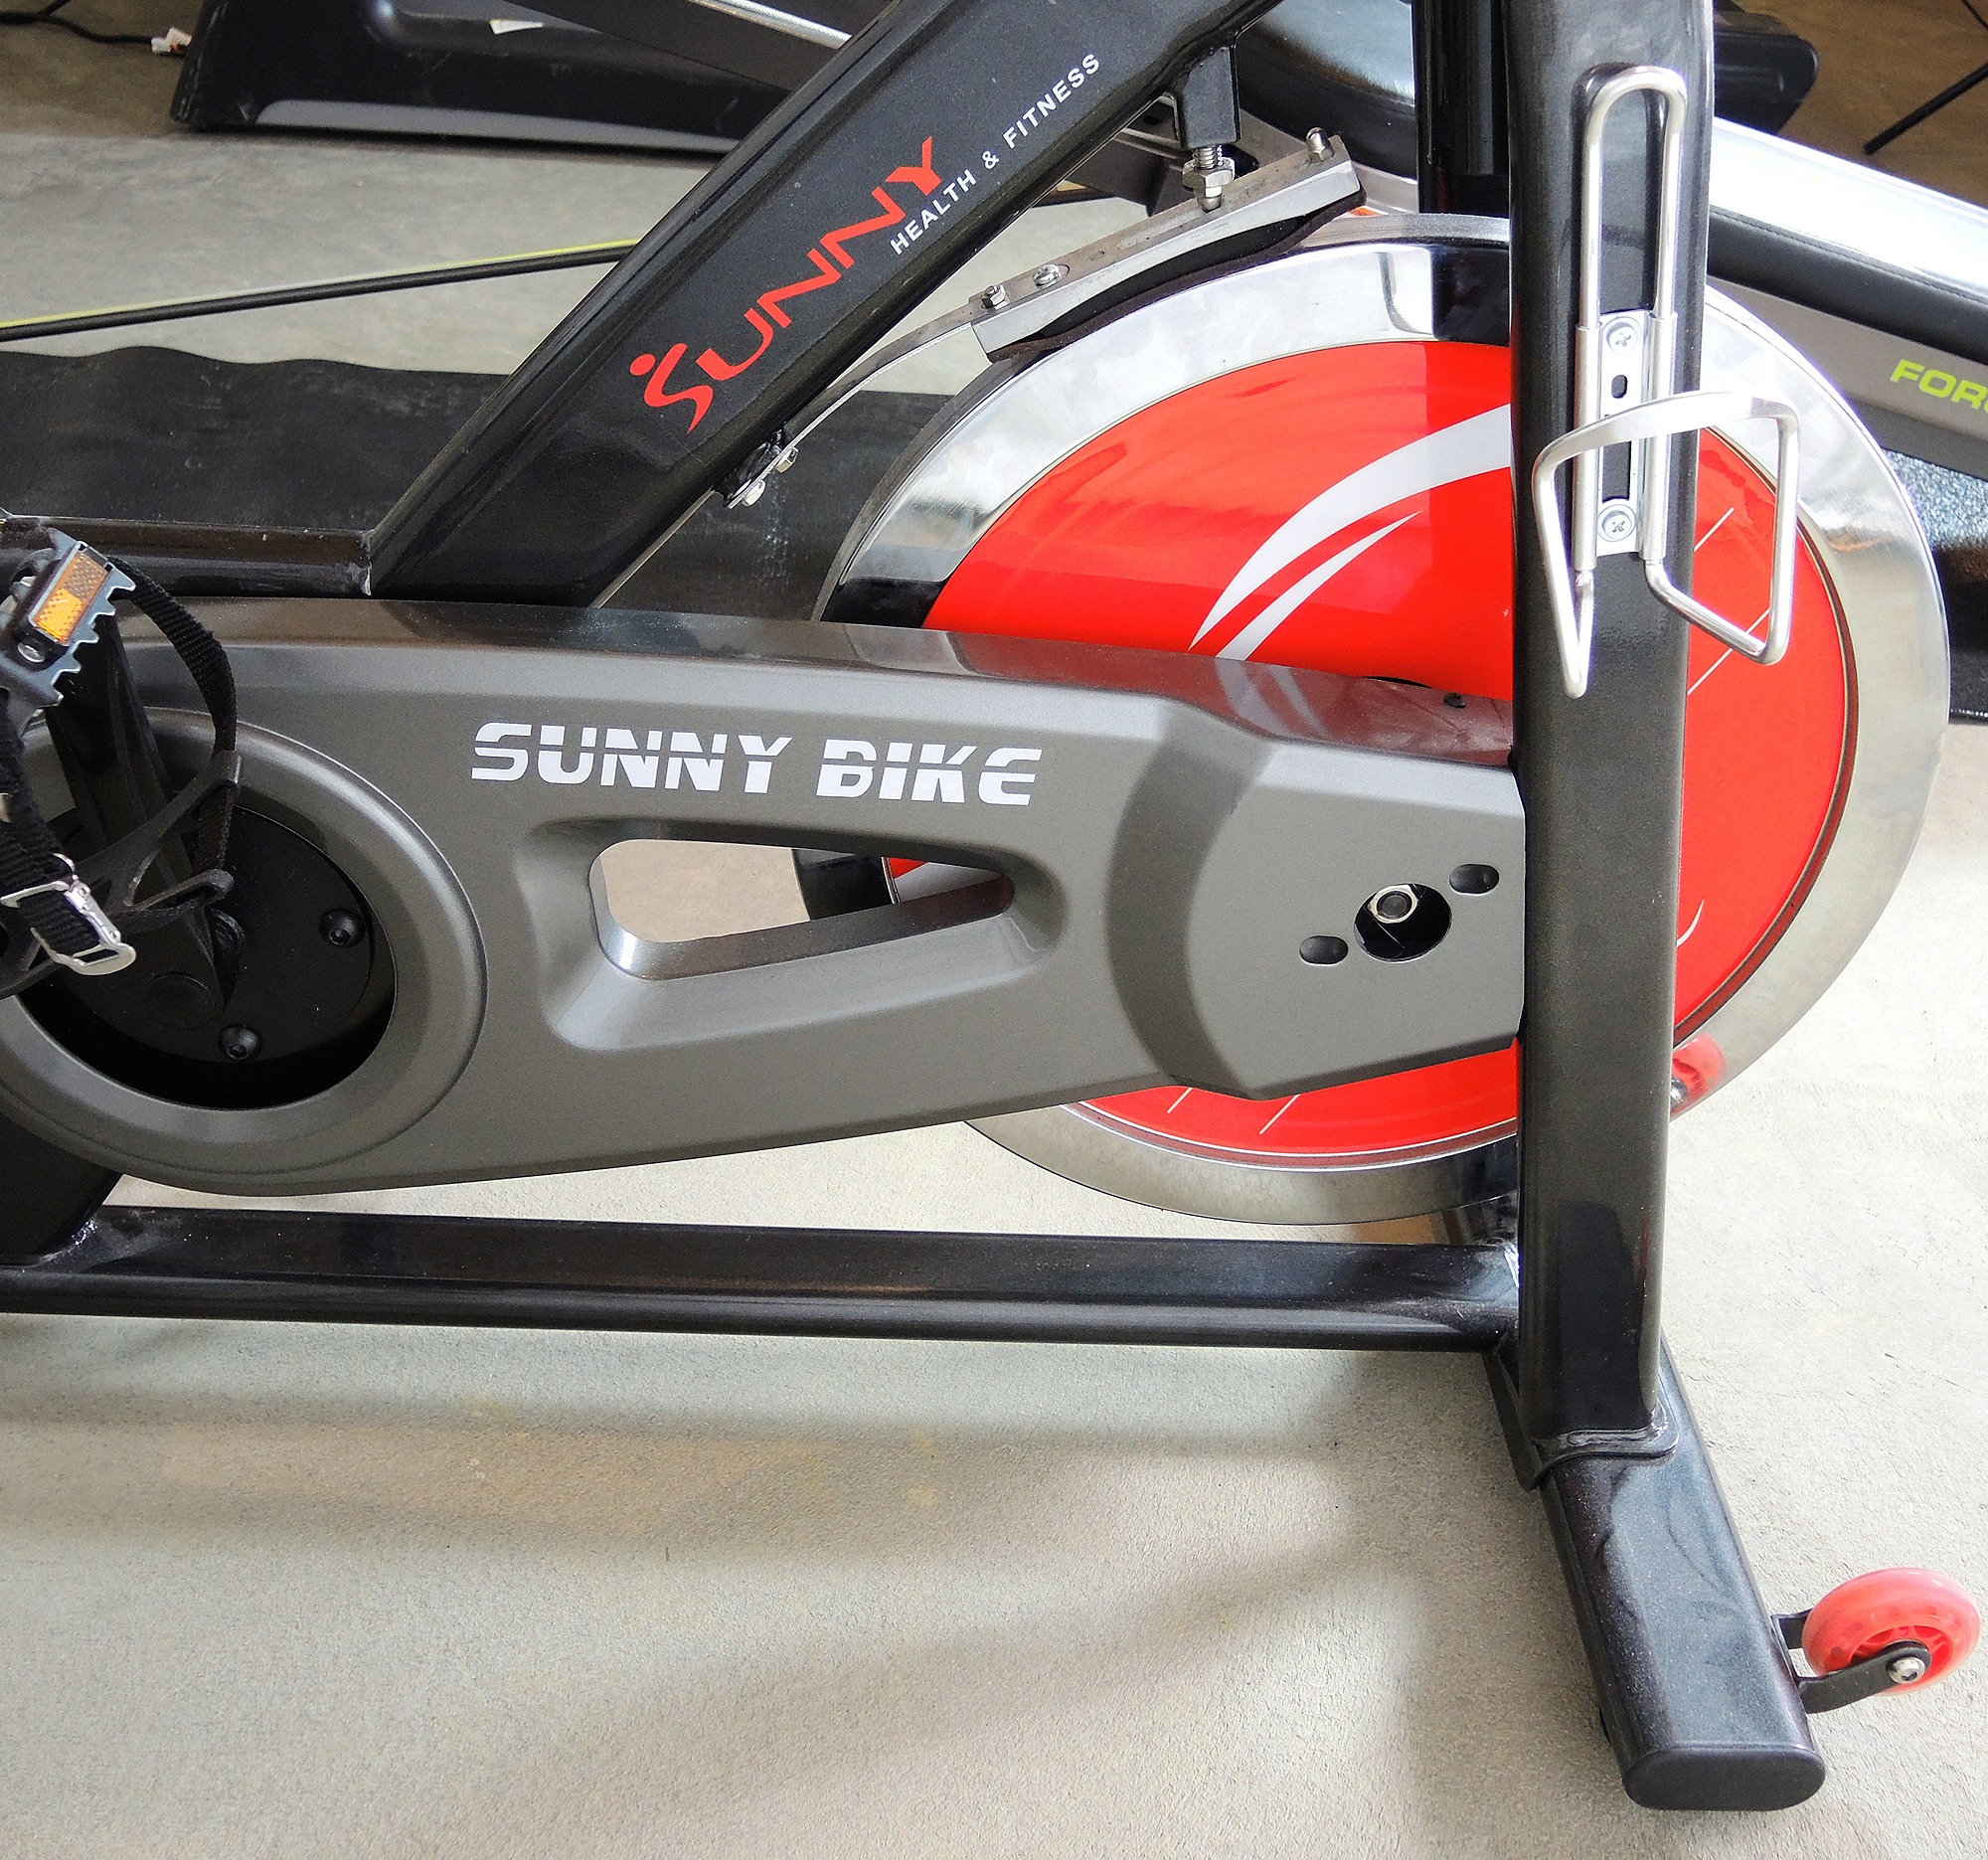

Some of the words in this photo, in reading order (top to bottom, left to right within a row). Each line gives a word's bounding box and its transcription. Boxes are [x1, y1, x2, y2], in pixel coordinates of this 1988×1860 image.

[890, 168, 978, 255] HEALTH
[981, 150, 1000, 170] &
[1002, 54, 1100, 149] FITNESS
[631, 135, 942, 432] SUNNY
[1890, 359, 1988, 414] FOR
[471, 722, 792, 793] SUNNY
[816, 739, 1043, 806] BIKE
